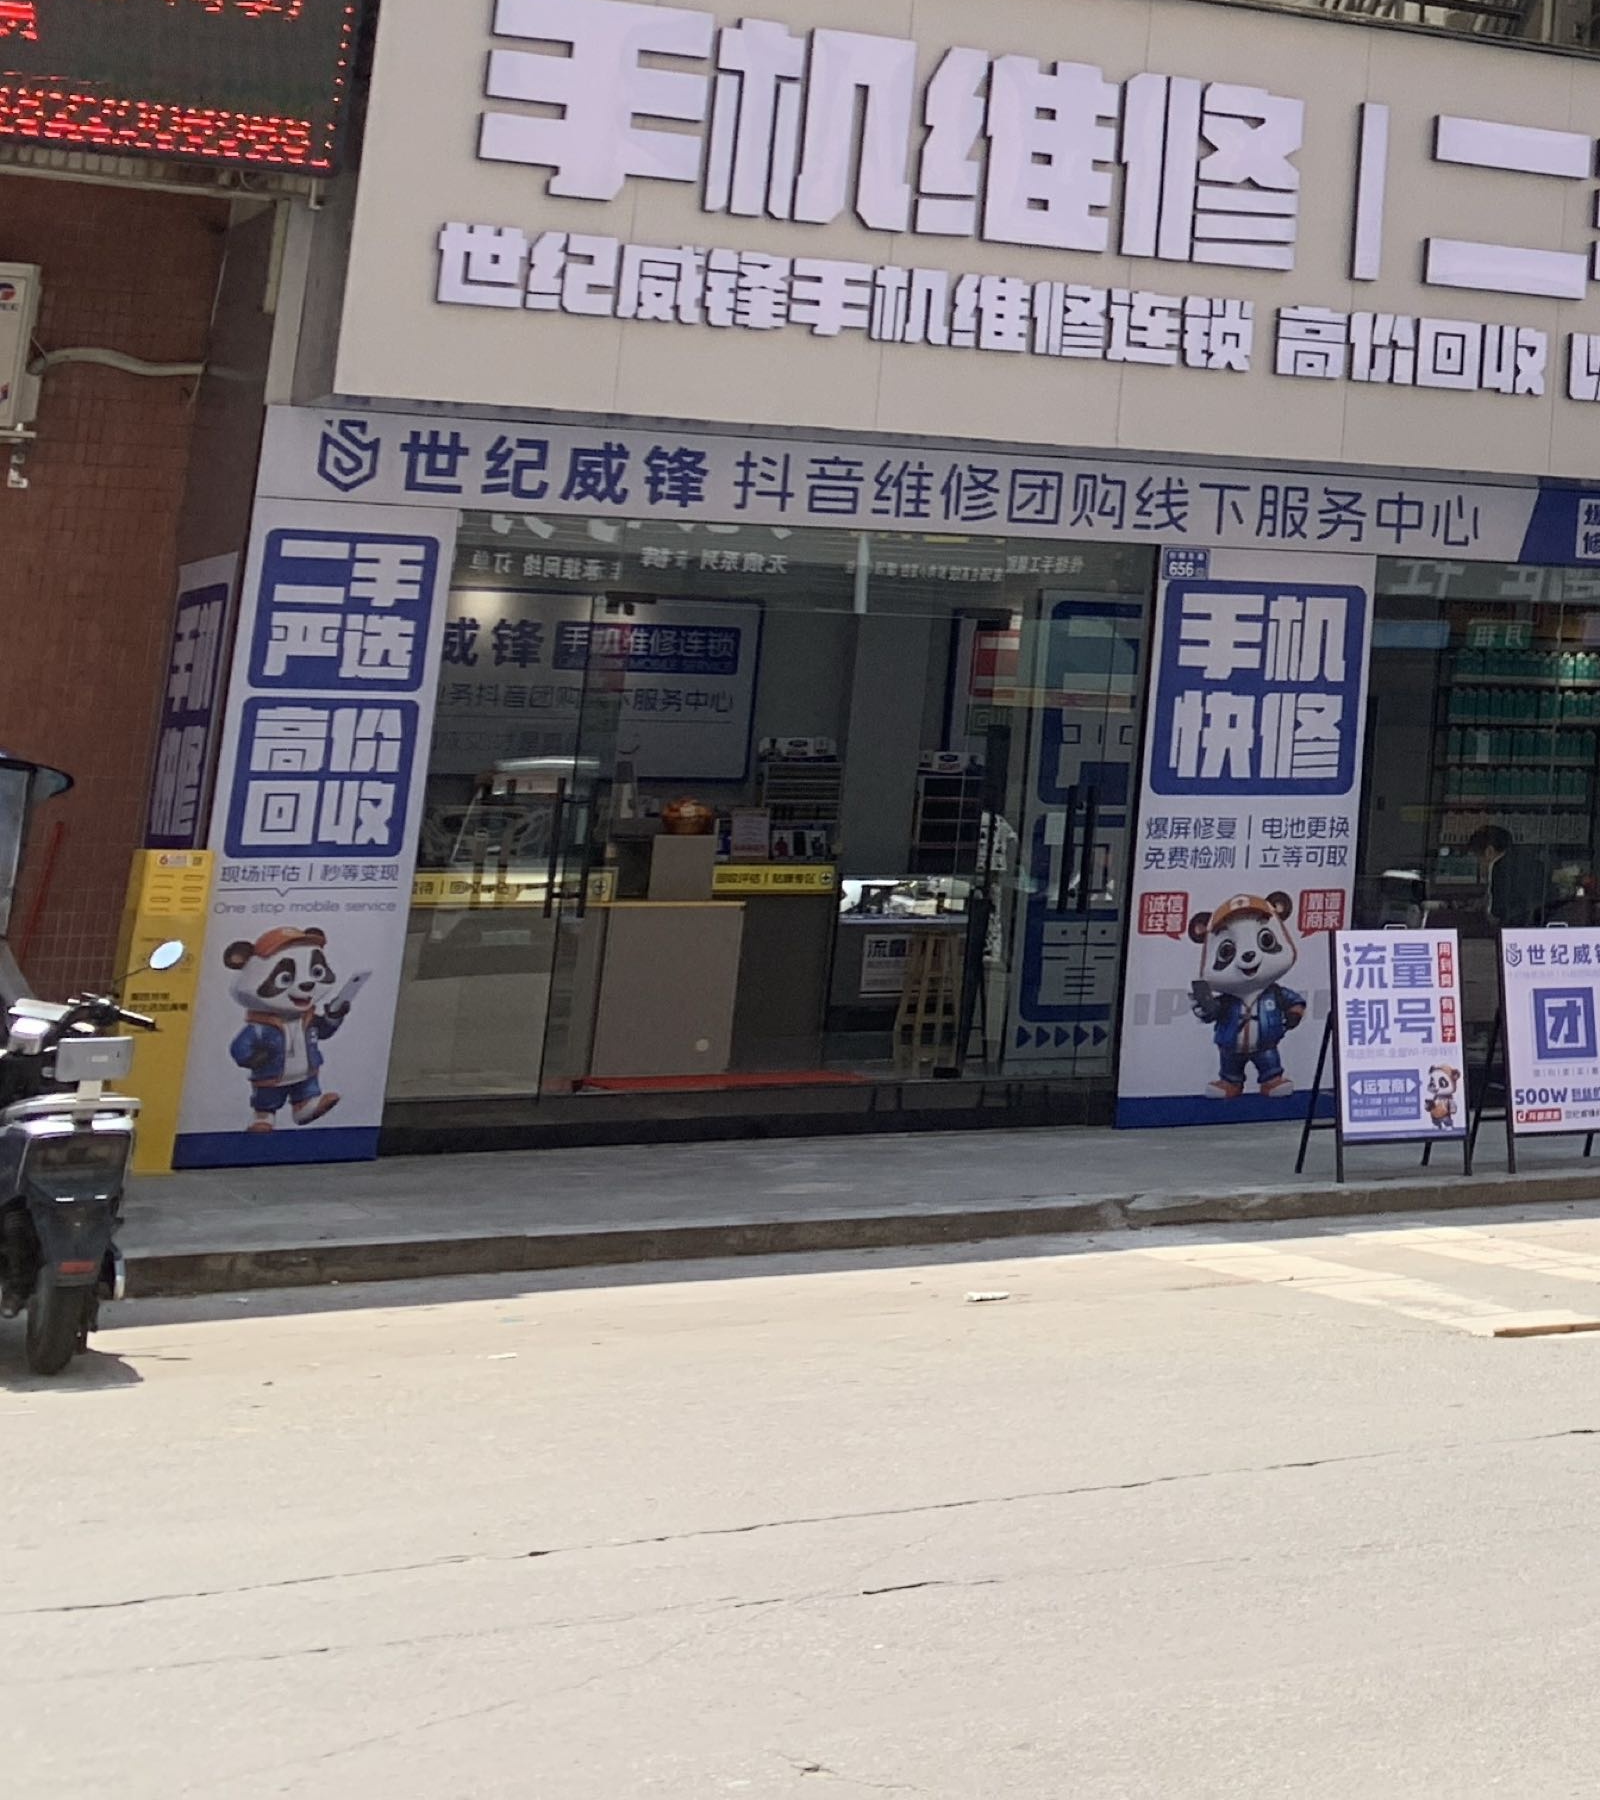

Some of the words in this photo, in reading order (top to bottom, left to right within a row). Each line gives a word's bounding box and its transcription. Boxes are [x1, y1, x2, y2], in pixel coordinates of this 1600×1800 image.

[436, 221, 1254, 371] 世纪威锋手机维修连锁
[1276, 304, 1548, 397] 高价回收
[400, 429, 711, 509] 世纪威锋
[733, 450, 1479, 546] 抖音维修团购线下服务中心
[272, 539, 427, 607] 二手
[1168, 560, 1195, 577] 656
[262, 611, 419, 680] 严选
[1178, 592, 1347, 684] 手机
[250, 706, 402, 773] 高价
[1169, 694, 1343, 780] 快修
[240, 778, 395, 850] 回收
[1145, 815, 1238, 840] 爆屏修复
[1261, 815, 1350, 840] 电池更换
[220, 864, 301, 883] 现场评估
[320, 864, 400, 883] 秒等变现
[1143, 846, 1237, 870] 免费检测
[1259, 845, 1348, 868] 立等可取
[213, 901, 246, 914] One
[251, 902, 284, 915] stop
[288, 900, 340, 913] mobile
[345, 901, 397, 913] service
[1144, 894, 1184, 913] 诚信
[1343, 942, 1433, 989] 流量
[1345, 998, 1435, 1046] 靓号
[1514, 1087, 1568, 1106] 500W
